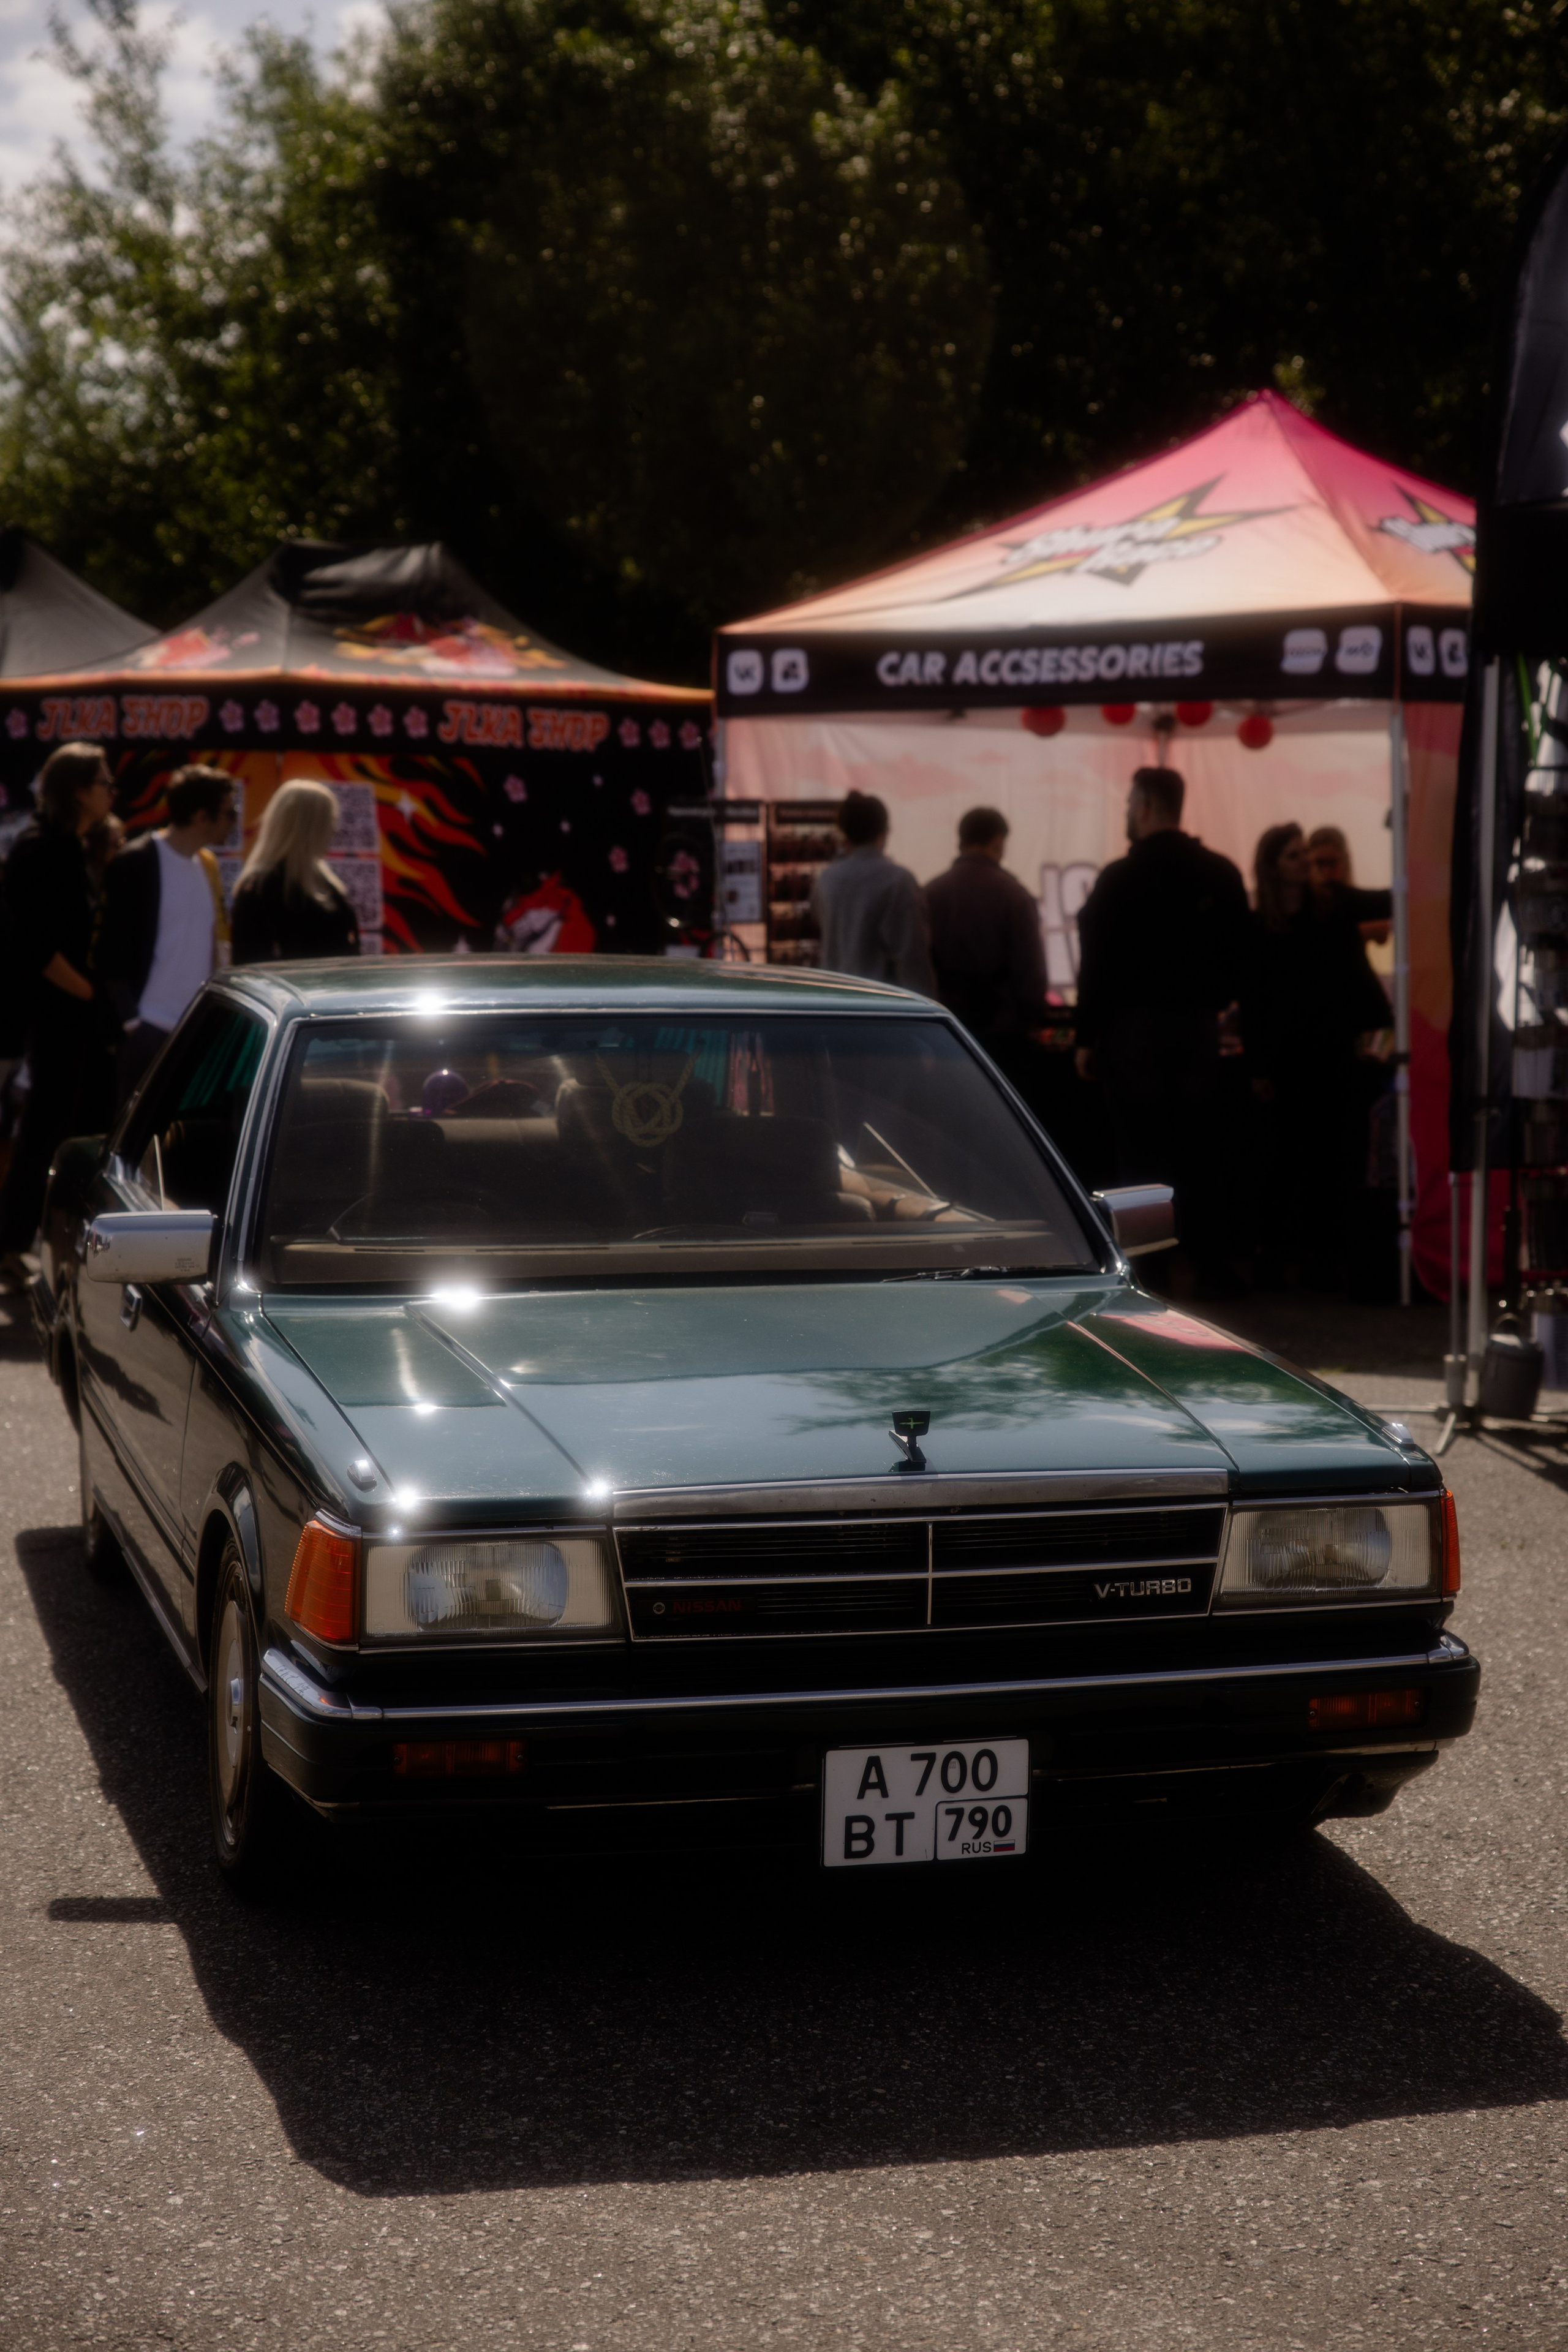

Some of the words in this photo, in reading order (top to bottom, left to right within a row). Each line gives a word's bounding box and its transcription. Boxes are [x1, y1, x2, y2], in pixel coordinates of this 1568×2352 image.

[875, 650, 947, 687] CAR
[951, 639, 1205, 686] ACCSESSORIES
[121, 694, 209, 740] SHOP
[526, 706, 611, 753] SHOP
[673, 1599, 742, 1614] NISSAN
[1093, 1578, 1192, 1599] V-TURBO
[857, 1755, 889, 1800] A
[910, 1749, 998, 1796] 700
[844, 1812, 915, 1859] BT
[944, 1804, 1012, 1841] 790
[961, 1841, 992, 1855] RUS
